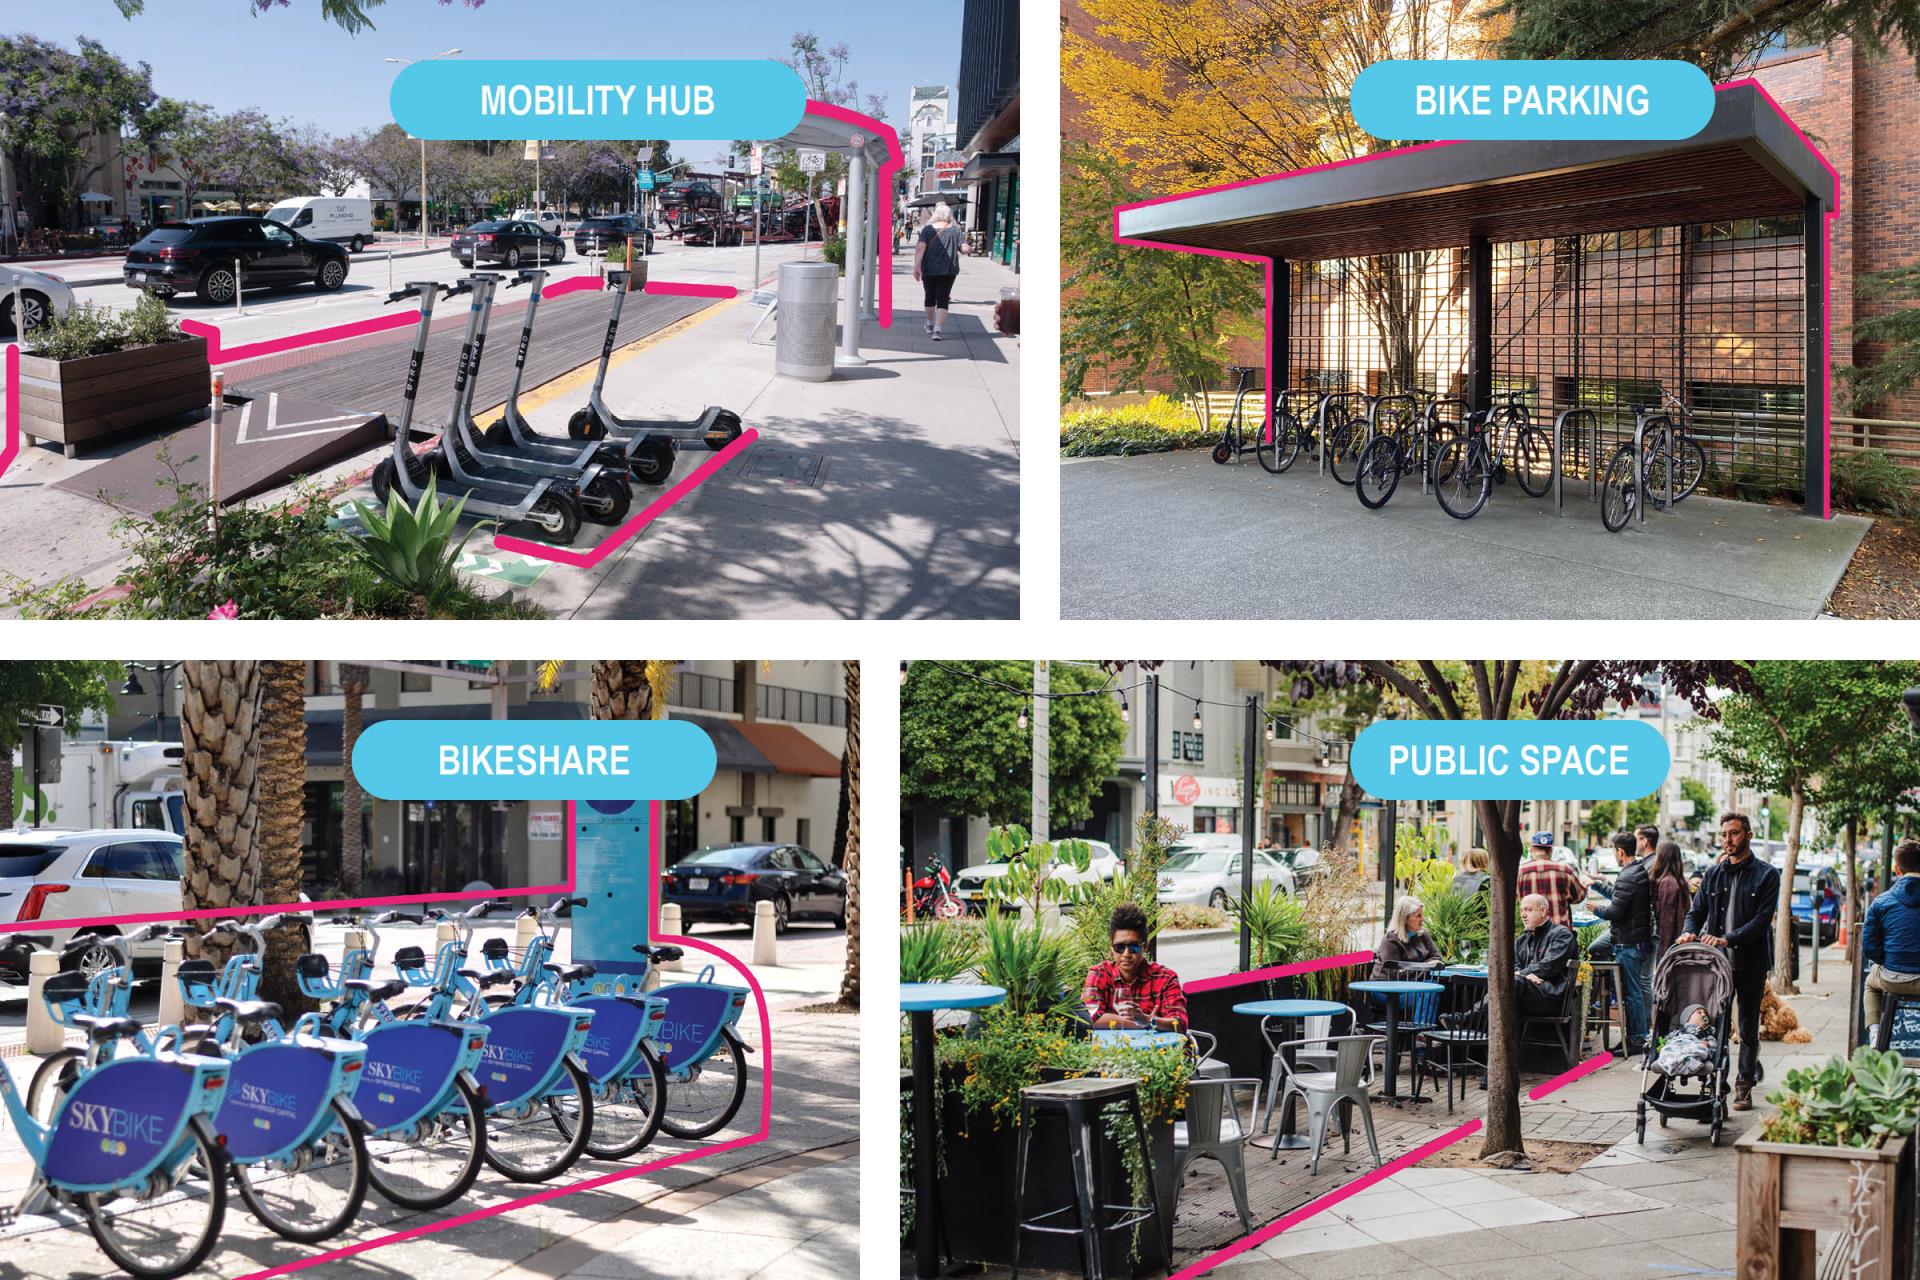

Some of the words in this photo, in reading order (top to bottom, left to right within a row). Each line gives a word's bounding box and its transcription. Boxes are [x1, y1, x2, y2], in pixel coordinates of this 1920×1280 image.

[518, 335, 529, 360] BIRD
[606, 327, 617, 351] BIRD
[457, 352, 469, 382] BIRD
[470, 340, 481, 367] BIRD
[407, 360, 418, 391] BIRD
[482, 1044, 535, 1065] SKYBIKE
[367, 1061, 424, 1087] SKYBIKE
[241, 1082, 297, 1112] SKYBIKE
[69, 1101, 165, 1146] SKYBIKE
